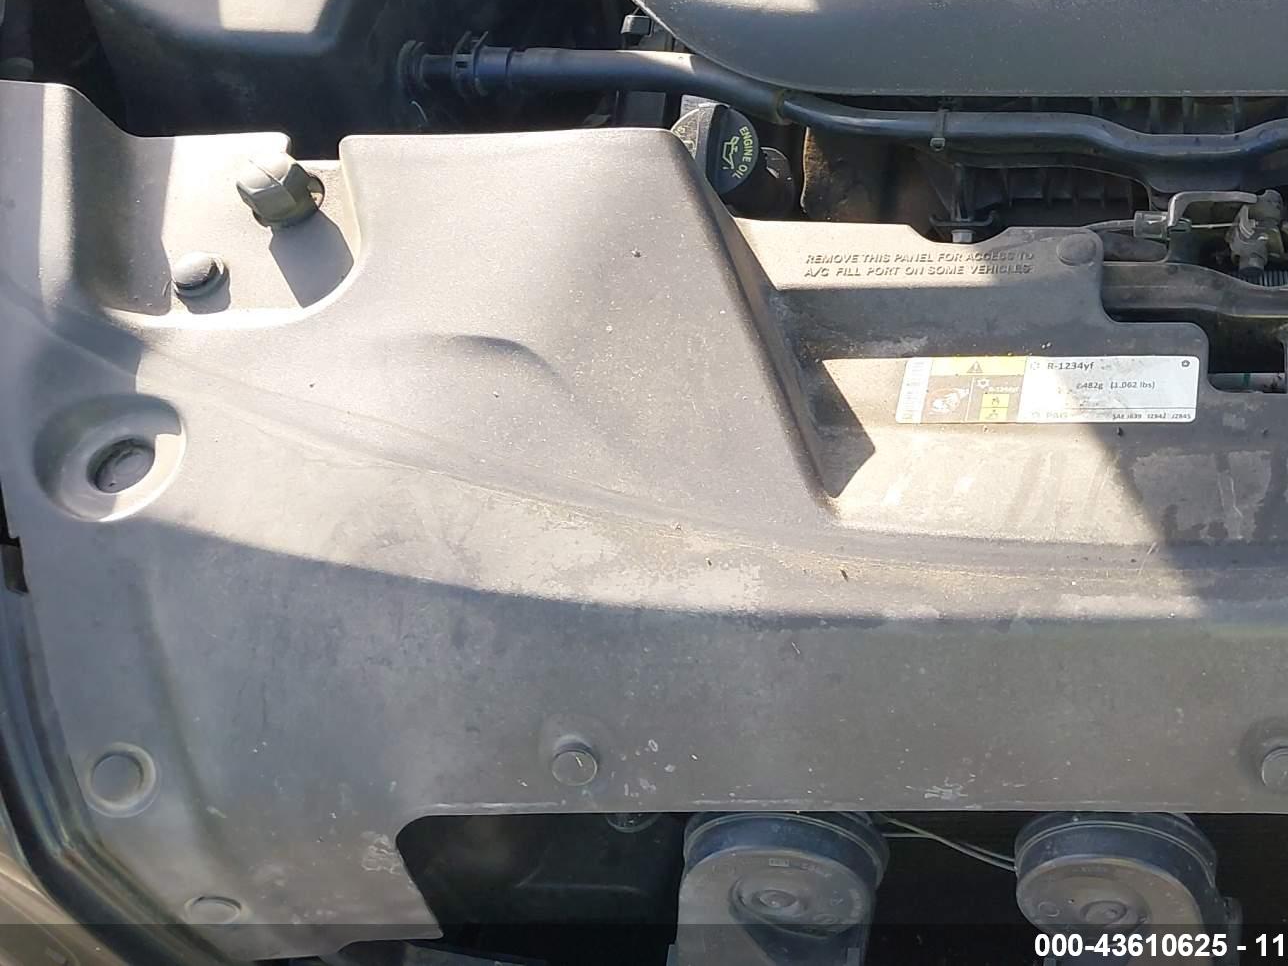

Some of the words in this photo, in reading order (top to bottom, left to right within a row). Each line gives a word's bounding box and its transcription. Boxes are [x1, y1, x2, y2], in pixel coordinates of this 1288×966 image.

[739, 126, 753, 163] ENGINE
[732, 164, 748, 179] OIL
[805, 253, 860, 265] REMOVE
[862, 253, 891, 264] THIS
[894, 252, 934, 264] PANEL
[937, 252, 964, 263] FOR
[966, 251, 1015, 262] ACCESS
[1018, 250, 1034, 261] TO
[803, 267, 830, 278] A/C
[836, 266, 861, 277] FILL
[866, 266, 901, 277] PORT
[905, 266, 925, 276] ON
[927, 265, 965, 276] SOME
[970, 264, 1033, 275] VEHICLES
[1047, 361, 1095, 372] R-1234yf
